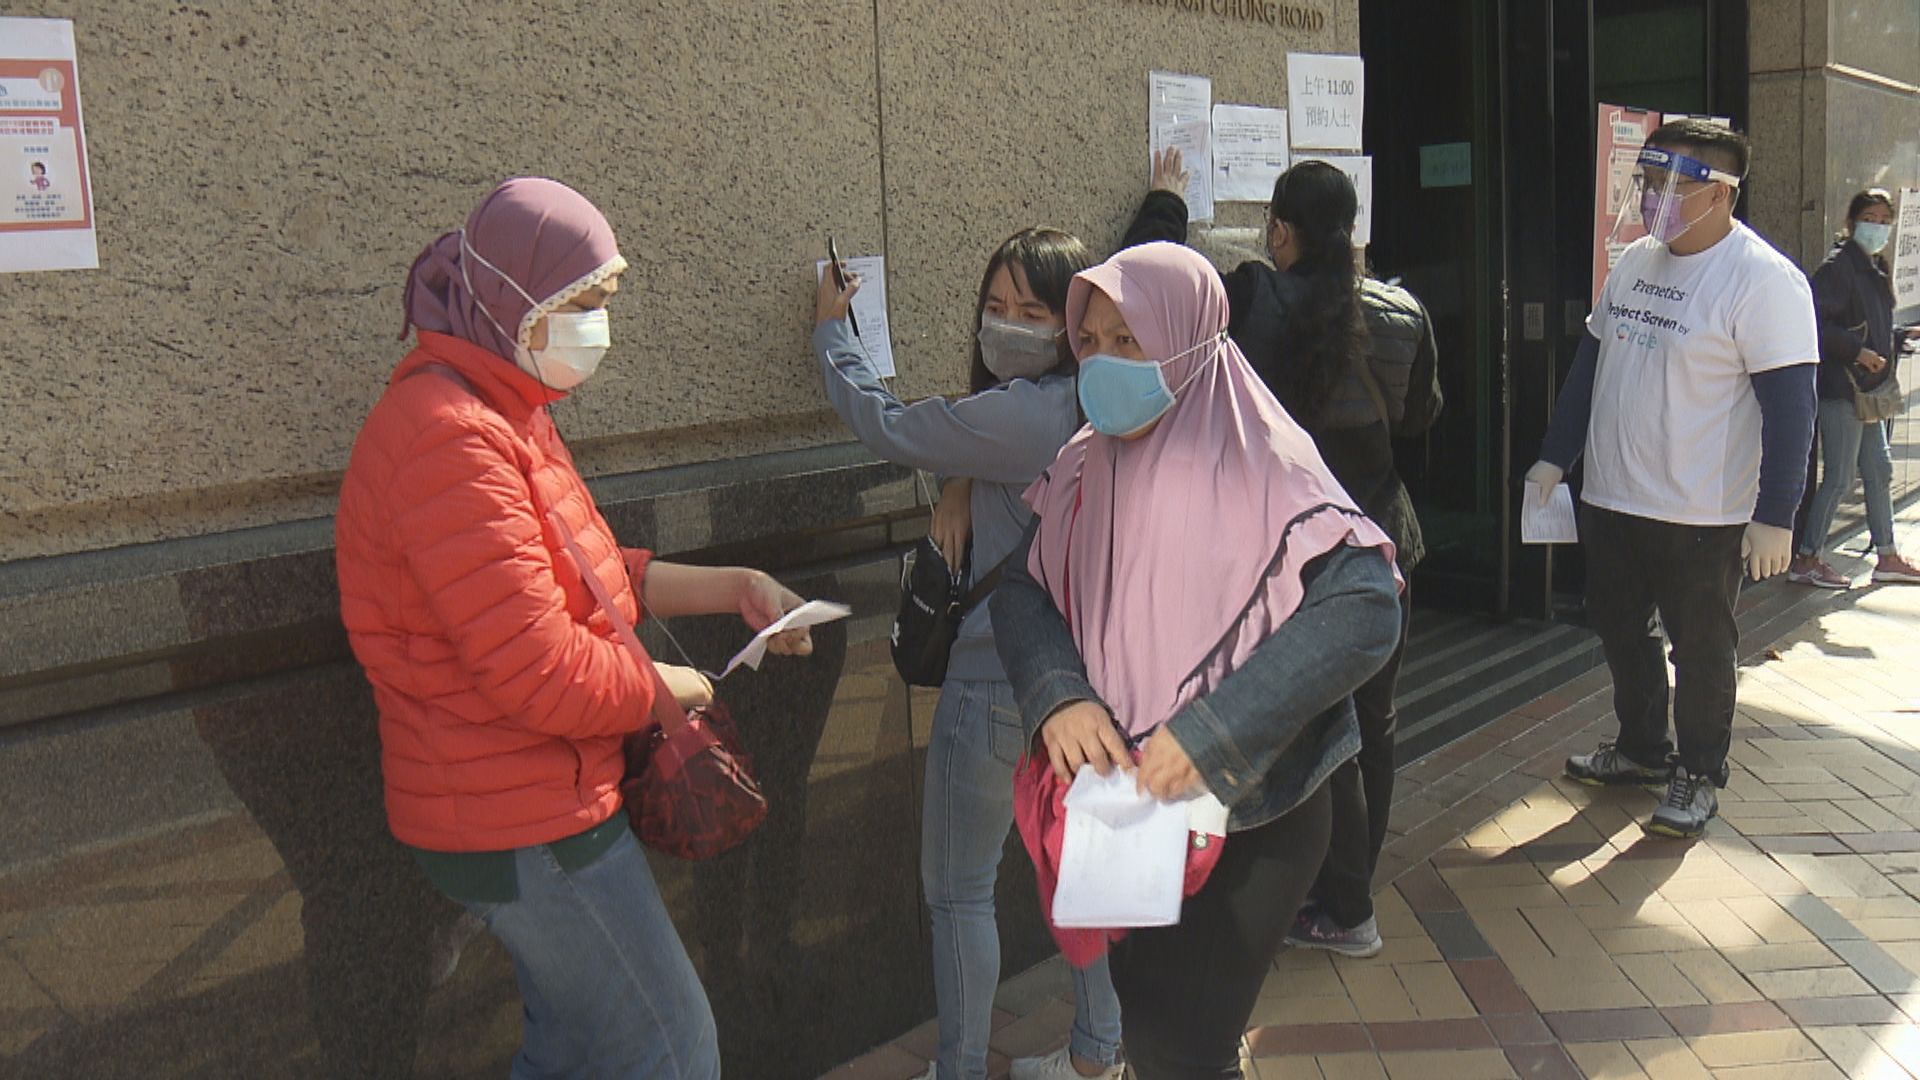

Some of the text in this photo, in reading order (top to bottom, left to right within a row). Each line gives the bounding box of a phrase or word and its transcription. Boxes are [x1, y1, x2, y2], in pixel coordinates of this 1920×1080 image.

[1211, 0, 1275, 26] CHUNG
[1279, 6, 1324, 32] ROAD
[1301, 75, 1354, 96] 上午 11:00
[1305, 106, 1351, 128] 預約人士
[1632, 278, 1686, 301] Prenetics
[1641, 310, 1677, 331] Screen
[1678, 324, 1691, 336] by
[1616, 323, 1657, 349] Circle
